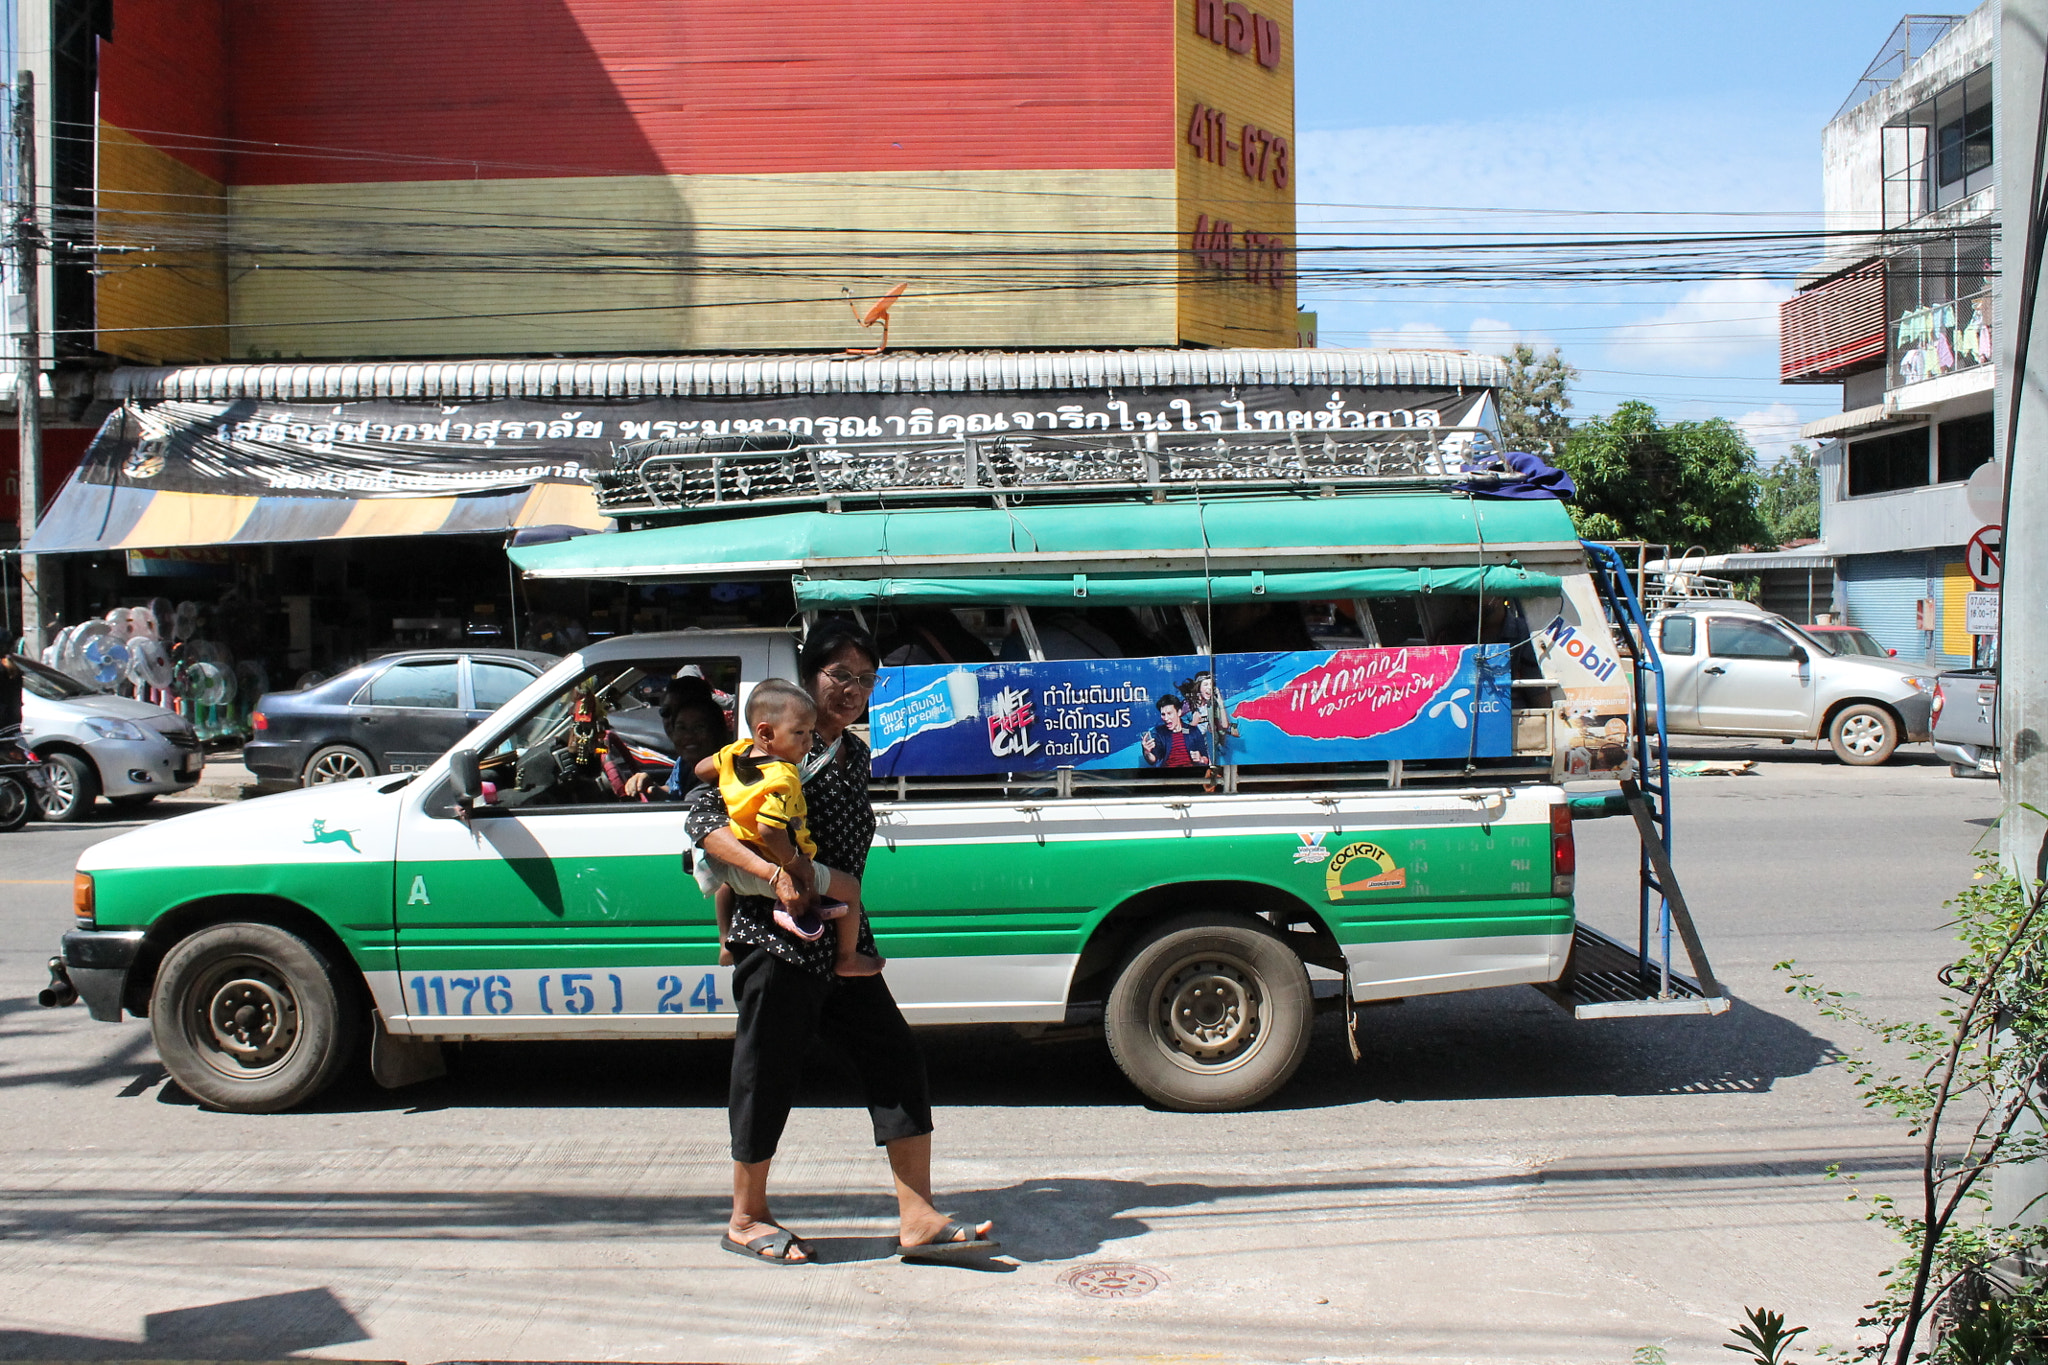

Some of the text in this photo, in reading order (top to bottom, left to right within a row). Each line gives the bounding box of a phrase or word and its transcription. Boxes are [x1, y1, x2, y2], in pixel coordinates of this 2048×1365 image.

[1188, 103, 1289, 190] 411-673
[1545, 615, 1617, 682] Mobil
[995, 685, 1030, 716] NET
[1043, 681, 1148, 706] ทำไมเติมเน็ต
[879, 692, 944, 726] ดีแทคเติมเงิน
[988, 702, 1034, 743] FREE
[1044, 707, 1131, 731] จะได้โทรฟรี
[883, 719, 907, 736] dtac
[992, 727, 1041, 757] CALL
[1045, 731, 1110, 756] ด้วยไม่ได้
[389, 764, 430, 773] EDG
[1331, 843, 1386, 873] COCKPIT
[407, 875, 431, 905] A
[410, 973, 723, 1015] 1176 (5) 24
